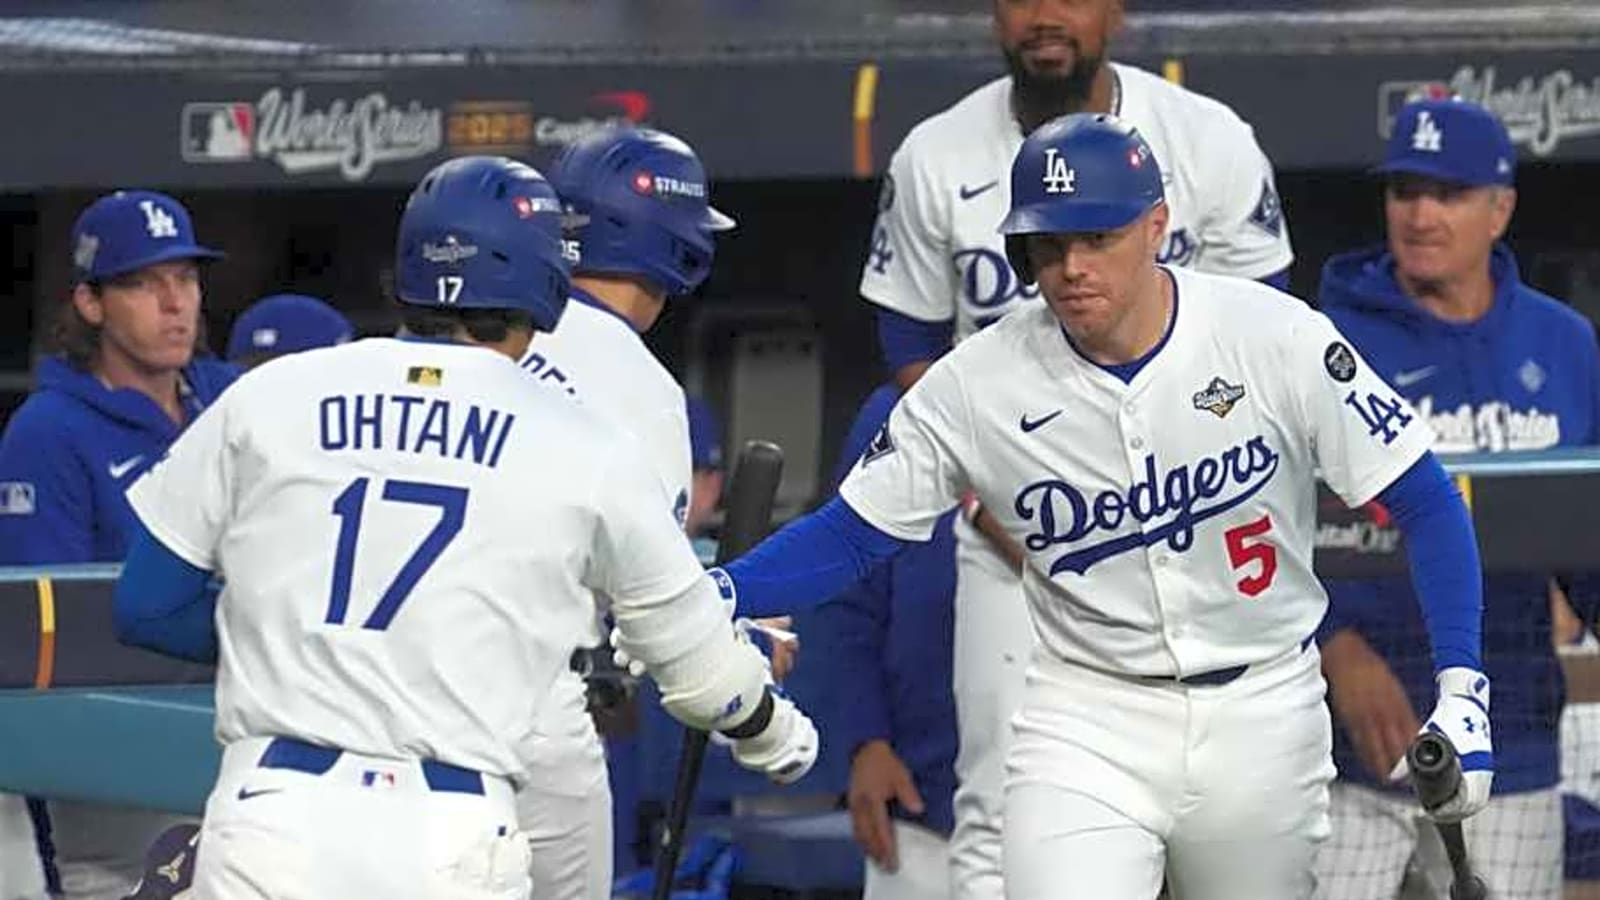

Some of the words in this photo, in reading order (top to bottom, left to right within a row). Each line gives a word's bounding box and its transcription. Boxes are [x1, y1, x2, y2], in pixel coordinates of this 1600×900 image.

[1413, 111, 1442, 151] LA
[1043, 148, 1075, 193] LA
[138, 201, 178, 238] LA
[437, 275, 464, 302] 17
[319, 394, 516, 469] OHTANI
[1344, 390, 1413, 445] LA
[1014, 434, 1279, 577] Dodgers
[324, 477, 470, 632] 17
[1224, 514, 1278, 598] 5
